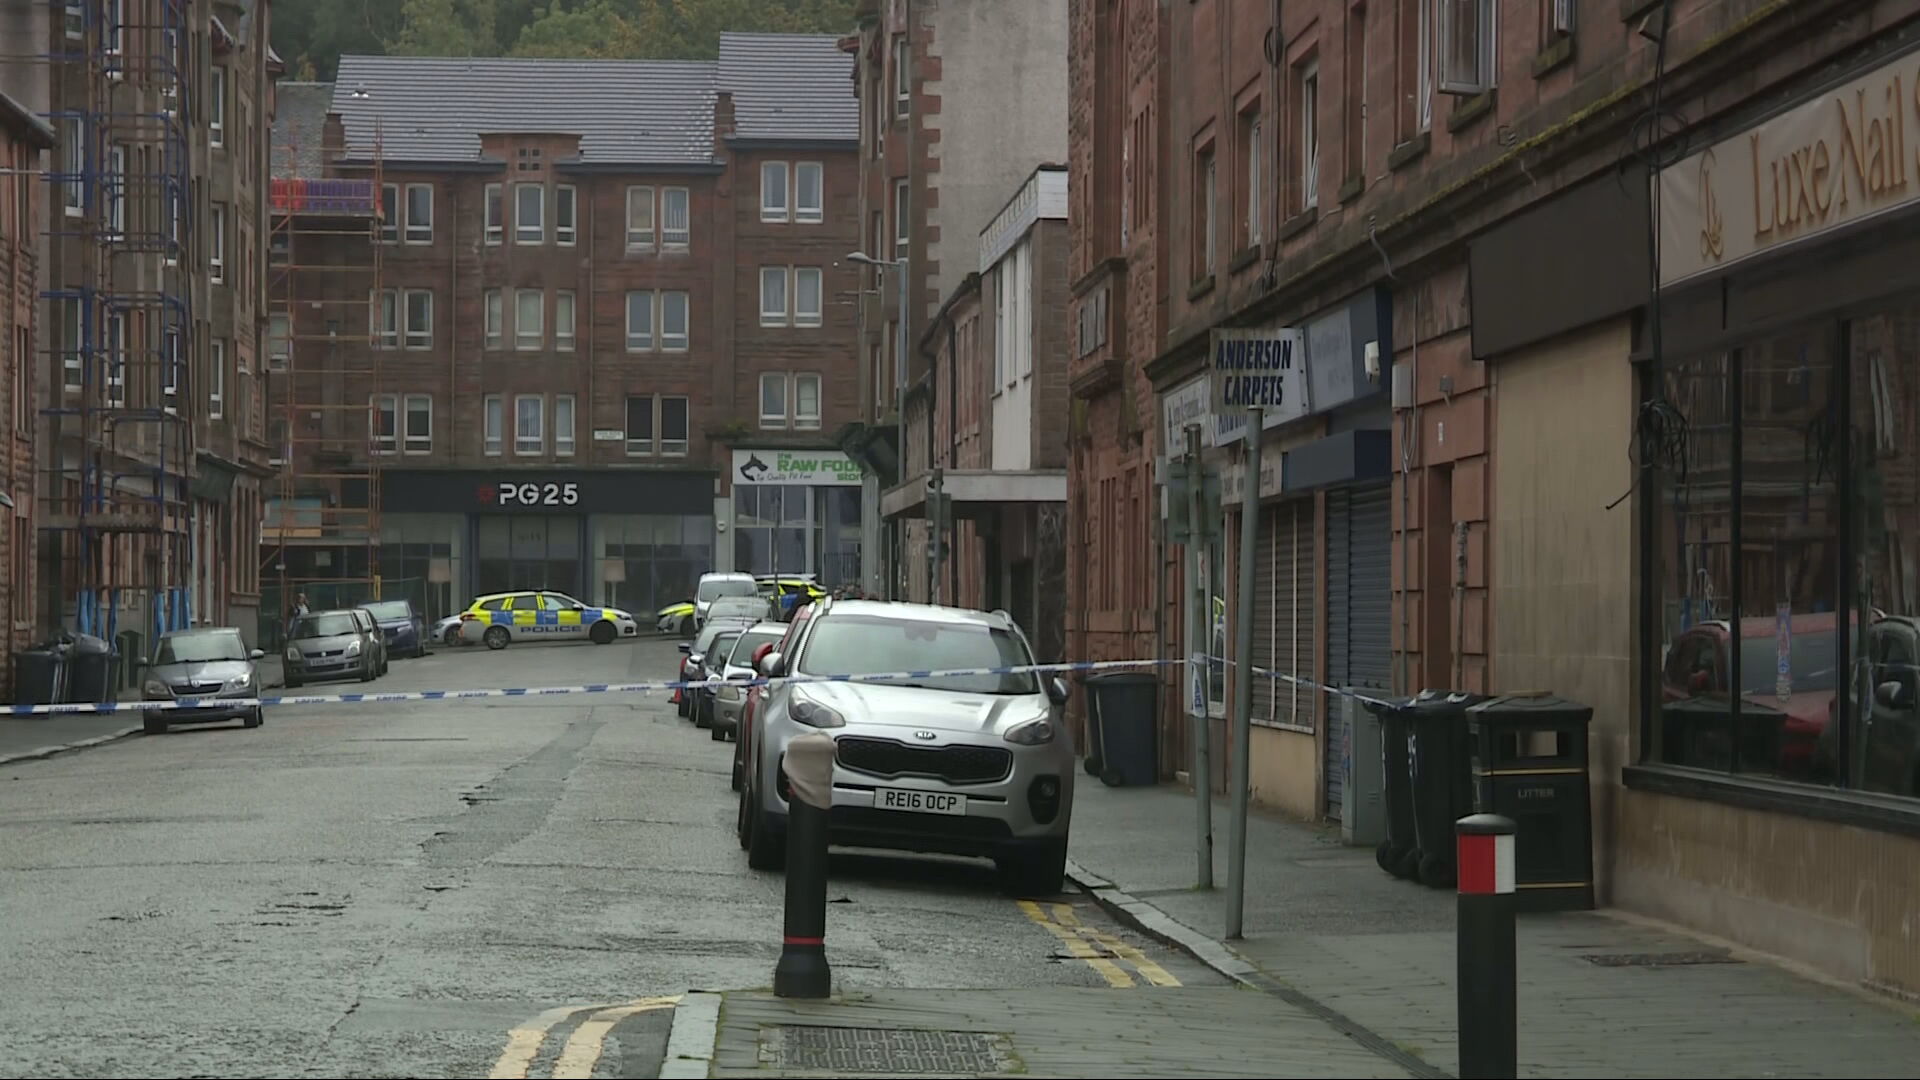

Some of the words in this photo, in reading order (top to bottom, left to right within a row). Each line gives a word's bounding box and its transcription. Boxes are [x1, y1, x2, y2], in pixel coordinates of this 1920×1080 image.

[1216, 339, 1292, 369] ANDERSON
[1224, 375, 1284, 405] CARPETS
[777, 459, 818, 472] RAW
[821, 460, 863, 472] FOO
[499, 483, 579, 505] PG25
[917, 731, 933, 739] KIA
[886, 791, 921, 808] RE16
[926, 795, 957, 811] OCP
[1518, 788, 1555, 799] LITTER
